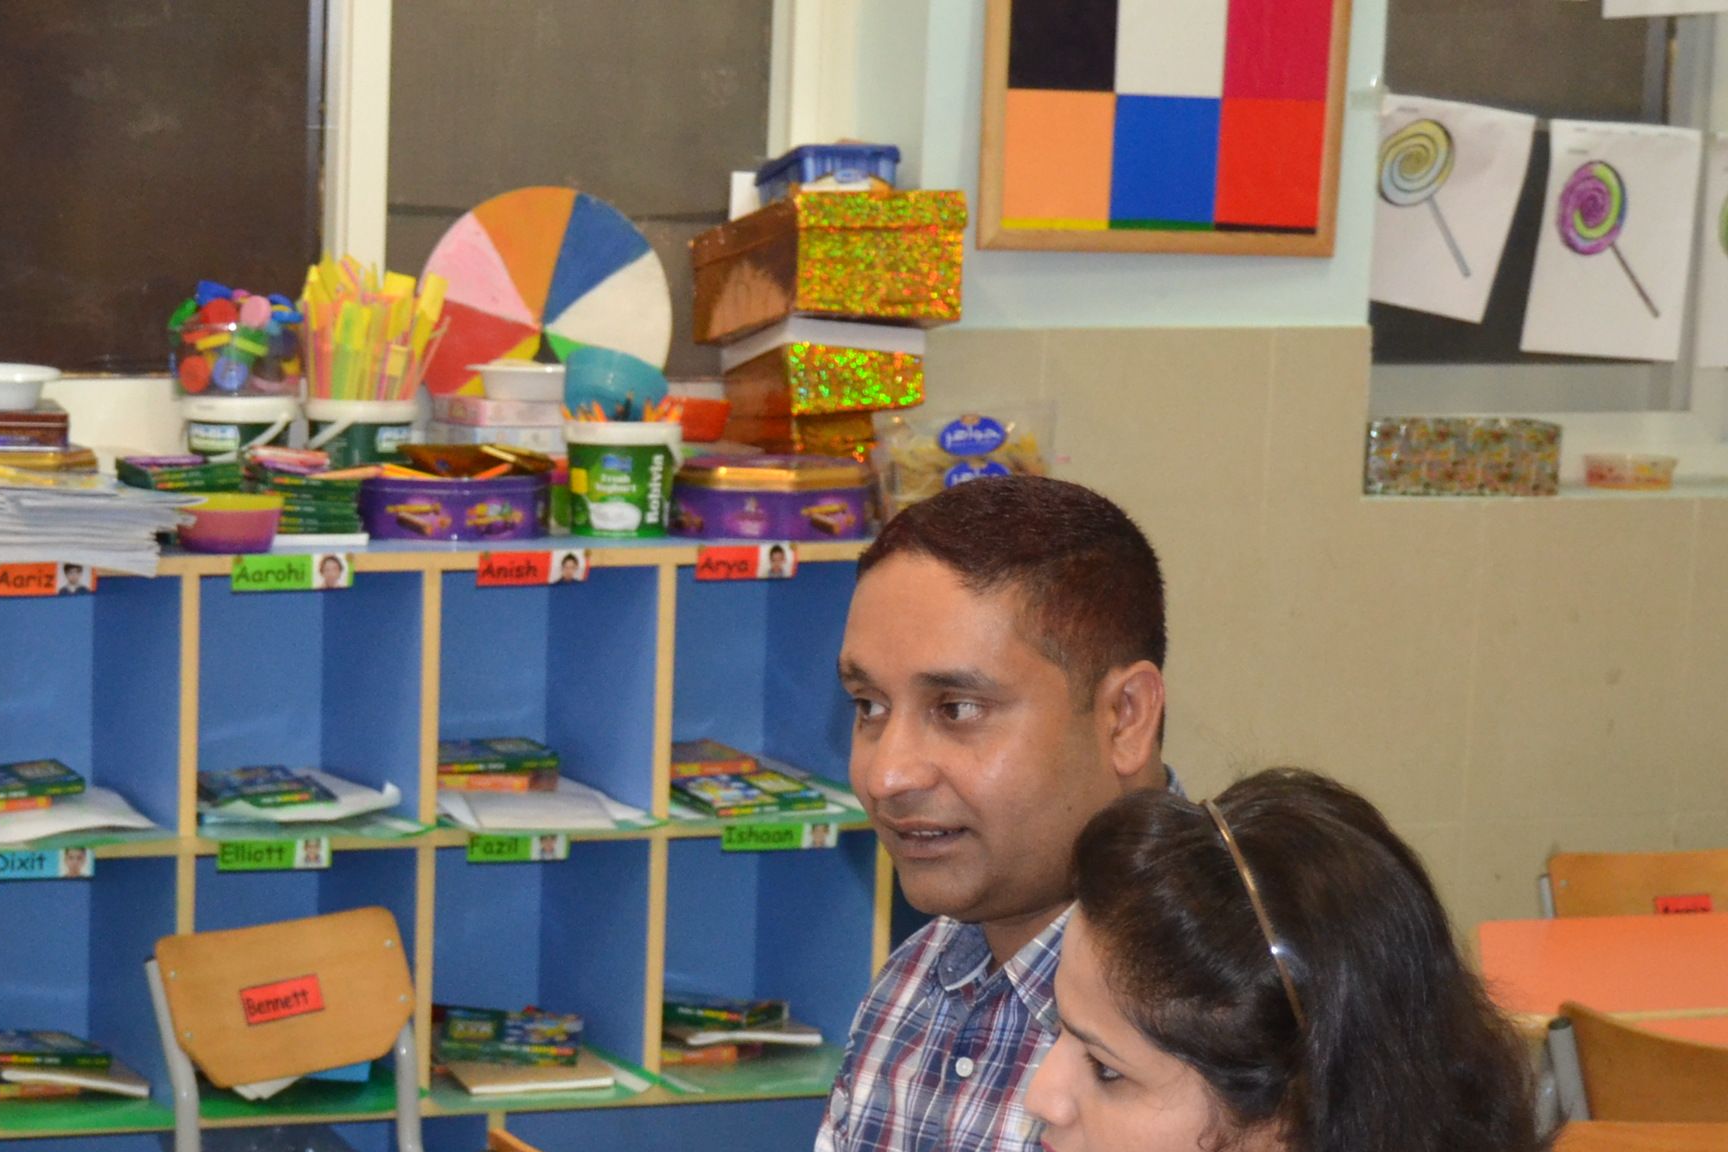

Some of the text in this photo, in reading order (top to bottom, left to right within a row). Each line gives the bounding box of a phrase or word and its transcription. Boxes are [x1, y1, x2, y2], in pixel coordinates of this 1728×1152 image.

[235, 562, 308, 584] Aarohi
[481, 561, 538, 580] Anish
[700, 557, 749, 578] Arya
[221, 842, 285, 864] Elliott
[245, 989, 309, 1017] Bennett
